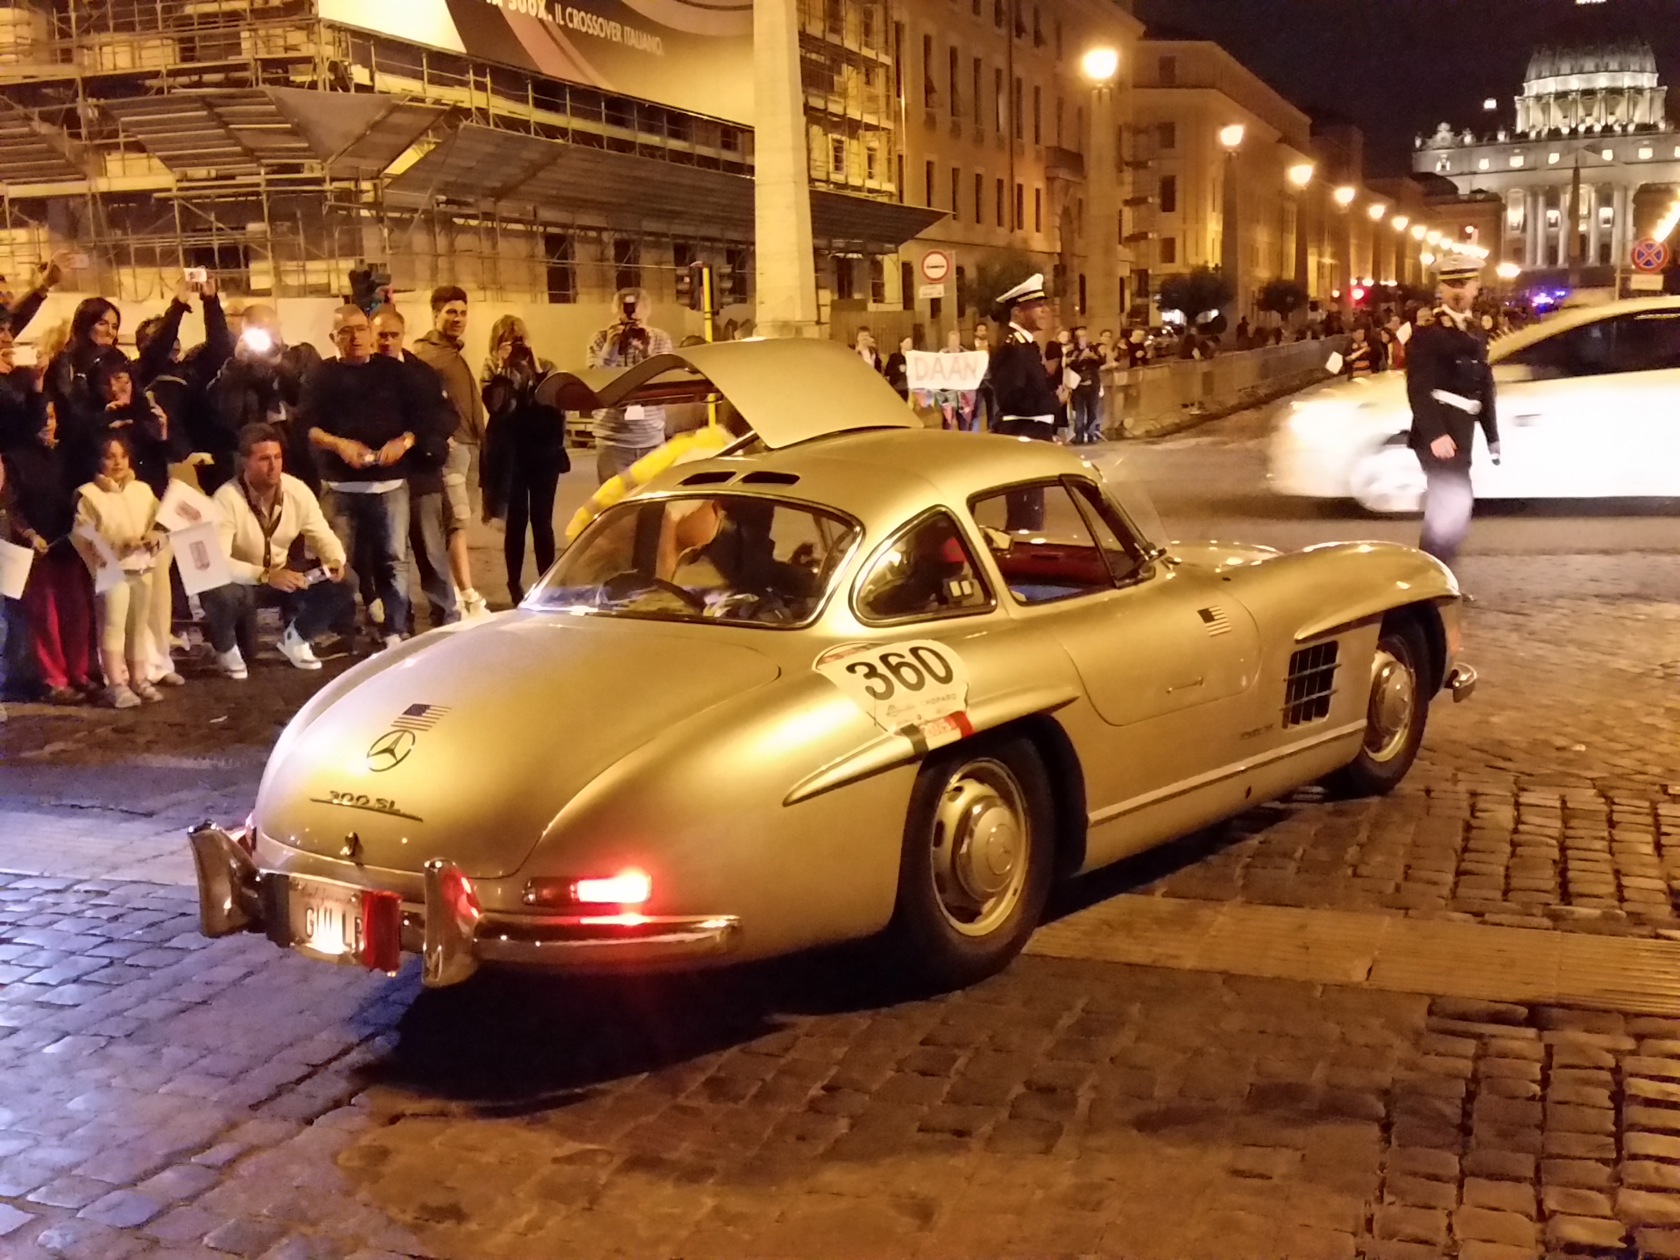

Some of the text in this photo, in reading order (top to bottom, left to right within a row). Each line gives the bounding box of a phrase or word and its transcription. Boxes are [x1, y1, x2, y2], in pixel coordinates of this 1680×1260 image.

[555, 3, 565, 25] IL
[566, 7, 622, 42] CROSSOVER
[913, 355, 978, 381] DAAN
[846, 647, 953, 700] 360
[328, 790, 401, 814] 300 SL
